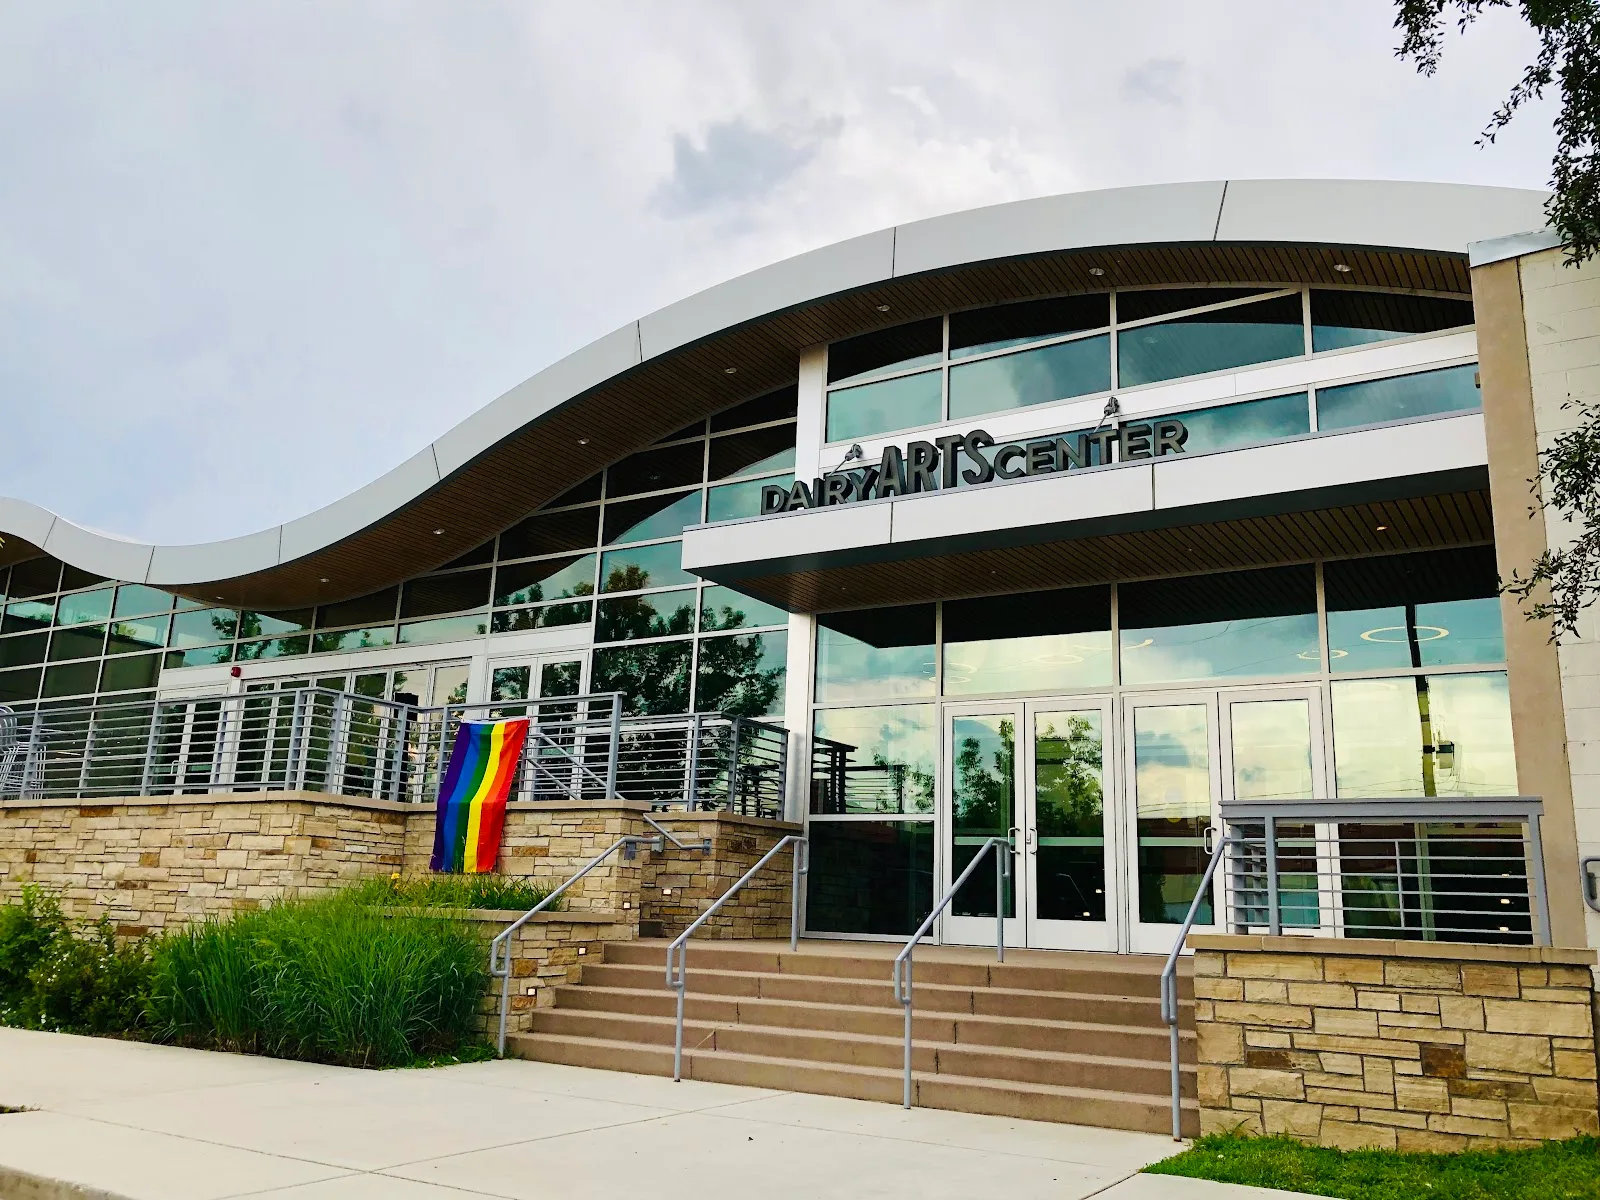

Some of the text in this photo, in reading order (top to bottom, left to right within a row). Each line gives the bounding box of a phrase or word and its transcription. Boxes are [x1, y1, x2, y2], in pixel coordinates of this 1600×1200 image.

[761, 420, 1188, 515] DAIRY ARTS CENTER
